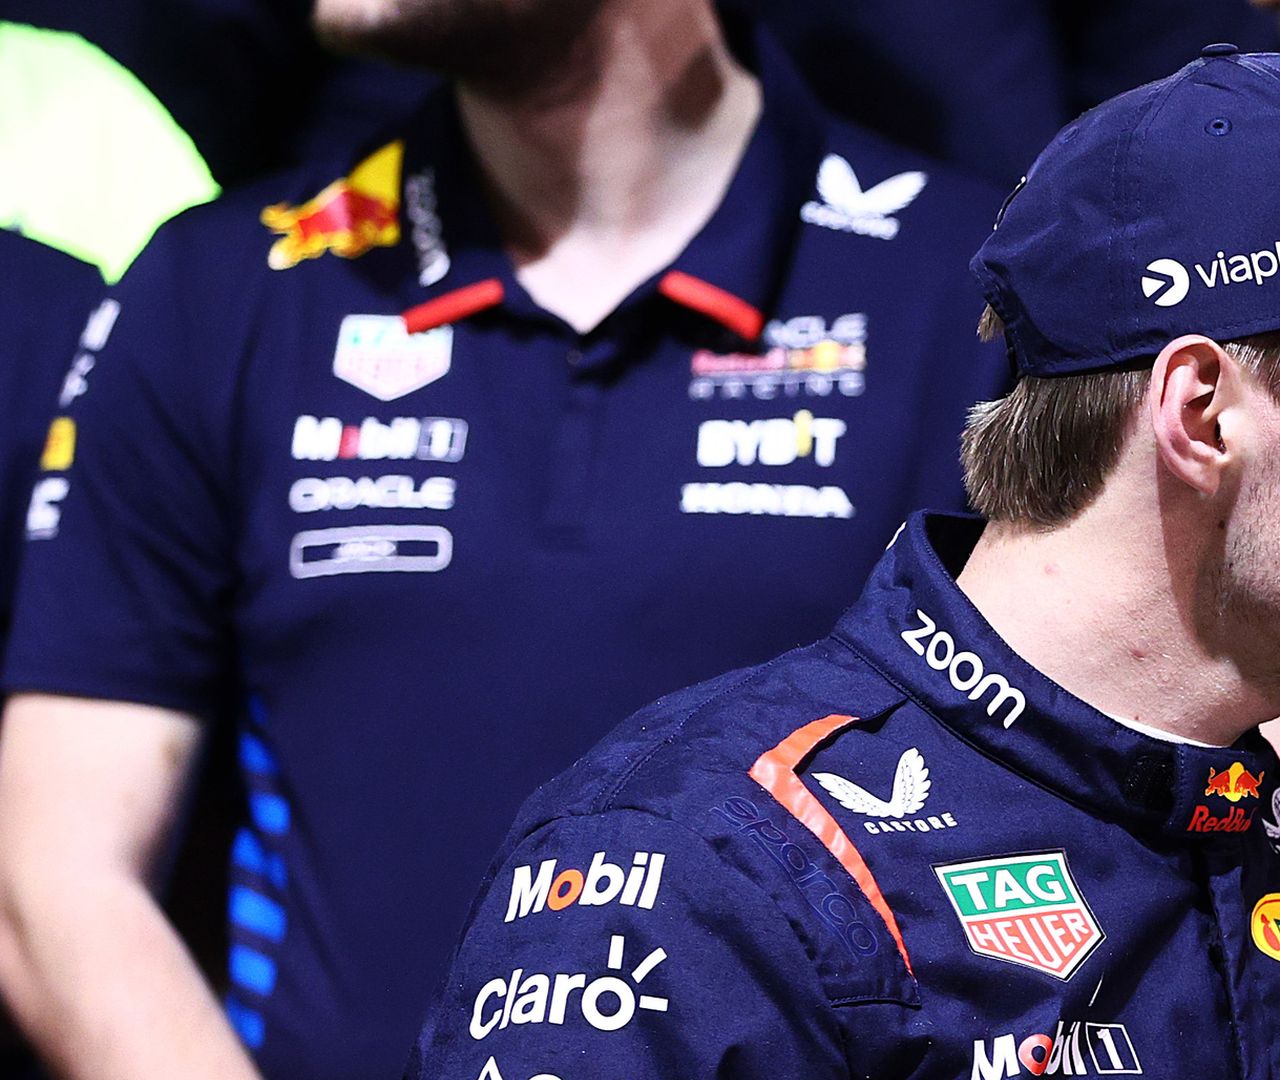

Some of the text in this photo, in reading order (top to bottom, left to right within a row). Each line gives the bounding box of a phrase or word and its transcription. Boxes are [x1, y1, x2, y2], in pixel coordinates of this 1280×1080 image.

[901, 609, 1026, 729] zoom
[863, 812, 958, 835] CASTORE
[505, 852, 665, 922] Mobil
[950, 865, 1067, 911] TAG
[970, 912, 1089, 971] HEUER
[1097, 1029, 1124, 1070] 1
